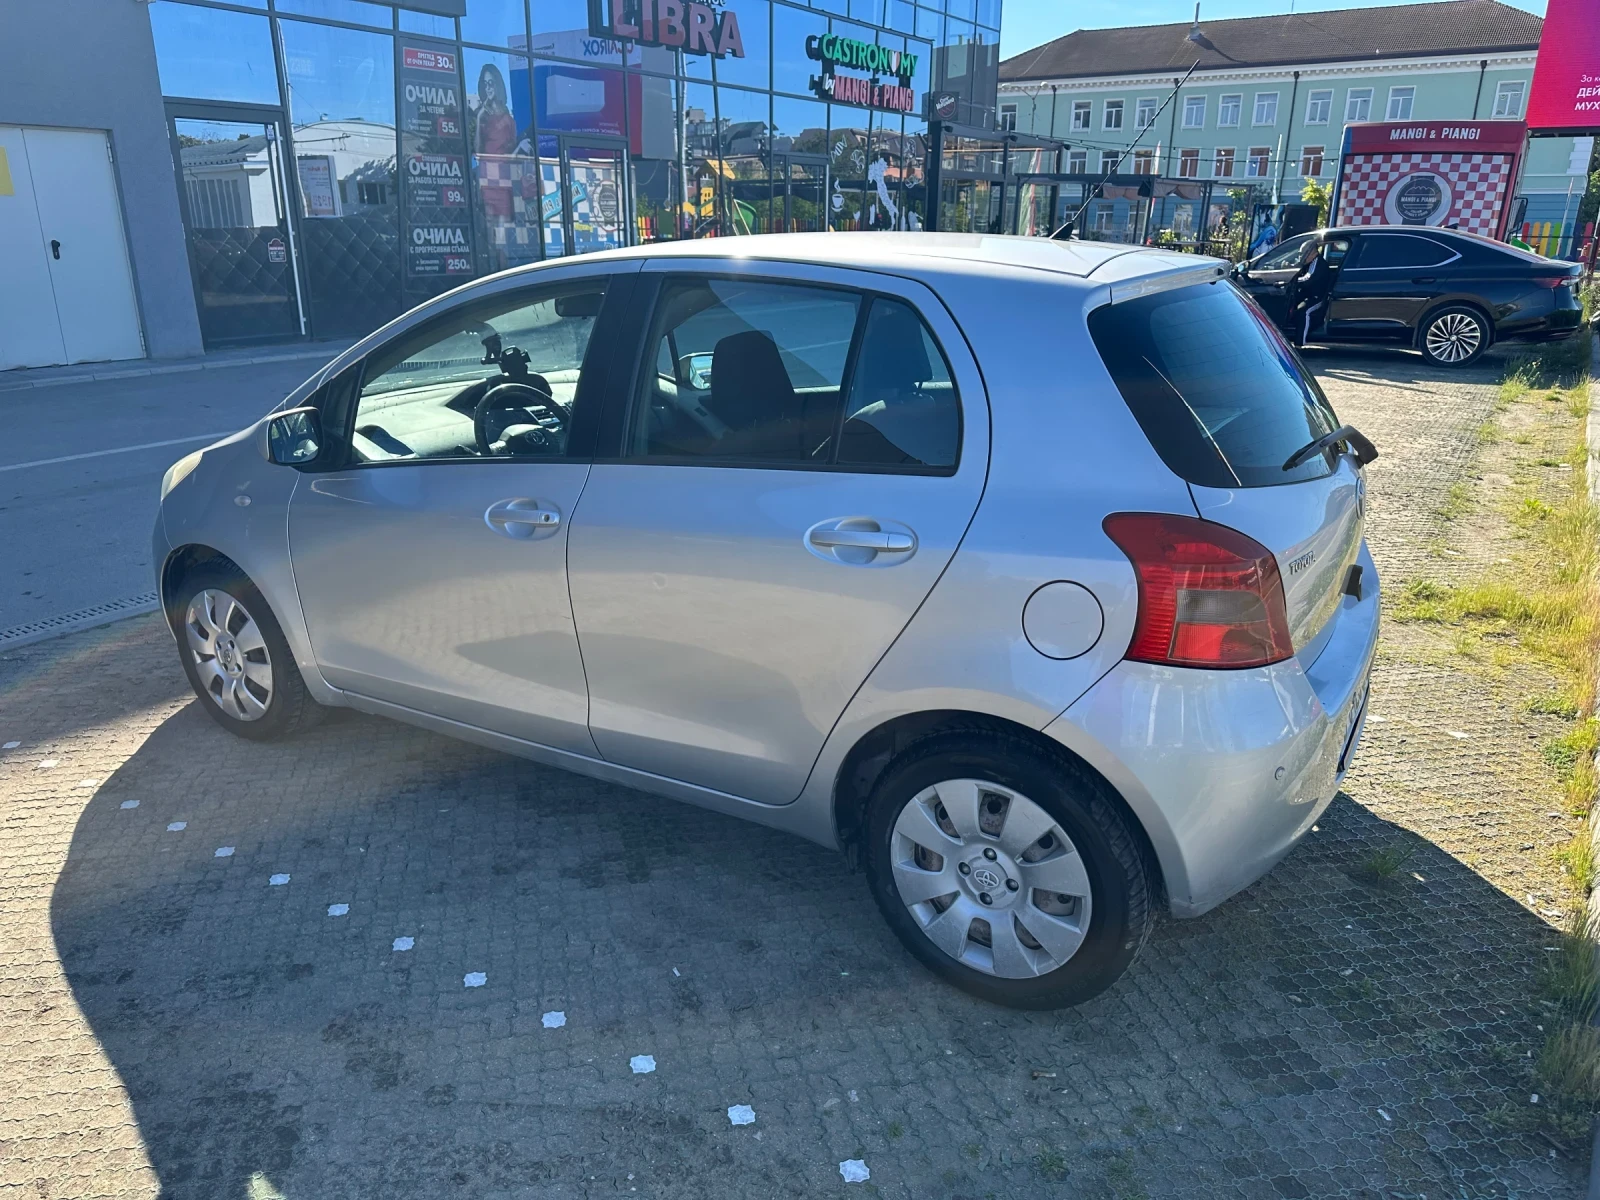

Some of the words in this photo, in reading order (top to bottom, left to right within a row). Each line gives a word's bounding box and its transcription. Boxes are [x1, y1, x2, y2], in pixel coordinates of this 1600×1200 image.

[612, 0, 745, 58] LIBRA
[405, 84, 456, 107] ОЧИЛА
[822, 72, 835, 95] by
[834, 75, 871, 106] MANGI
[873, 86, 880, 106] &
[883, 84, 914, 112] PIANGI
[1389, 127, 1427, 140] MANGI
[1429, 129, 1436, 139] &
[1441, 127, 1481, 140] PIANGI
[408, 158, 462, 177] ОЧИЛА
[413, 227, 465, 245] ОЧИЛА
